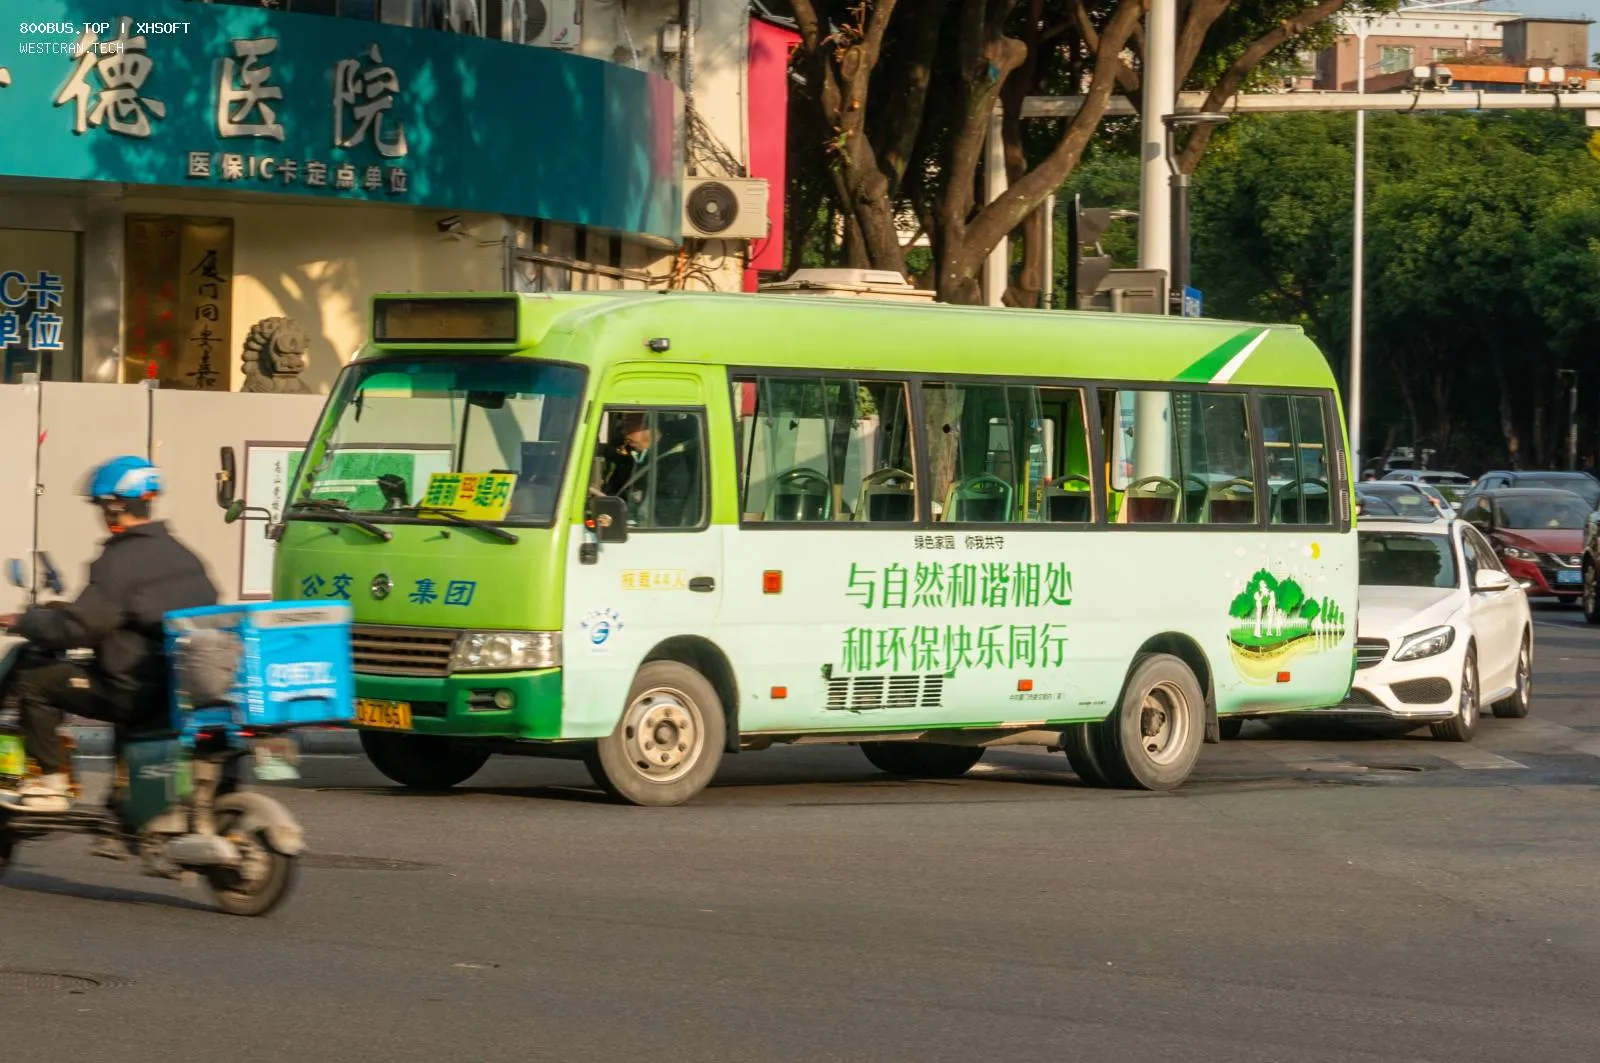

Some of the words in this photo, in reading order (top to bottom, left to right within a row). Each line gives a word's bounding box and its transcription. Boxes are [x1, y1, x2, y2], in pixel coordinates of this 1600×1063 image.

[0, 15, 409, 158] 德医院
[188, 151, 408, 194] 医保IC卡定点单位
[914, 535, 955, 550] 绿色家园
[965, 535, 1004, 550] 你我共守
[301, 573, 354, 600] 公交
[408, 578, 477, 607] 集团
[845, 561, 1073, 609] 与自然和谐相处
[841, 623, 1069, 672] 和环保快乐同行
